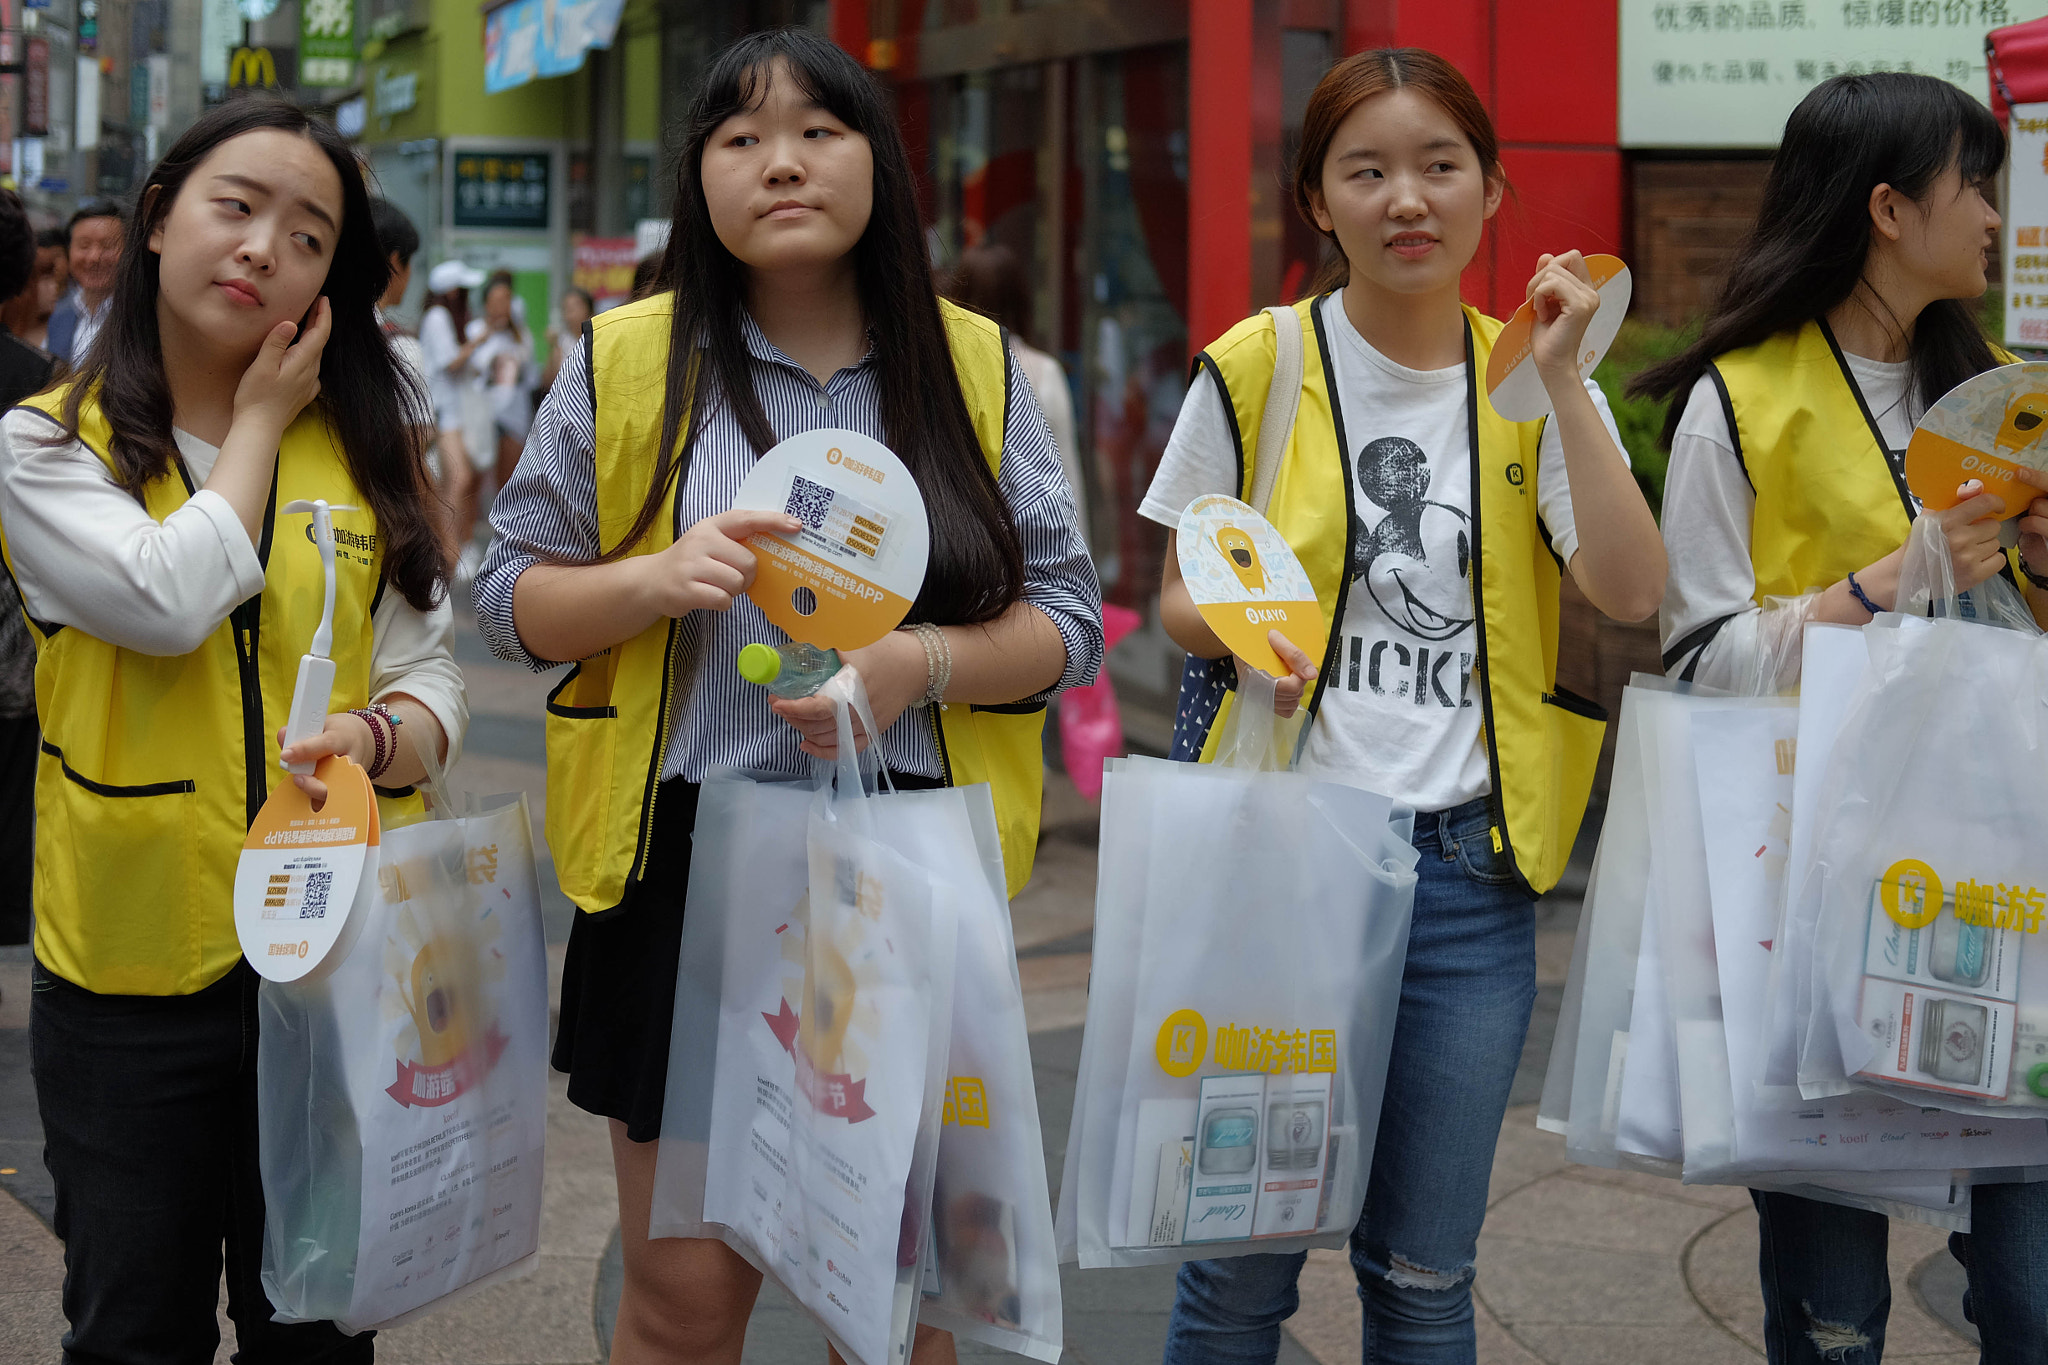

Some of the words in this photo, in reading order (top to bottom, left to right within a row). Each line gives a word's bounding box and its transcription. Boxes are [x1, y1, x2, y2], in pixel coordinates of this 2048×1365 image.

[842, 456, 885, 485] 咖游韩国
[1976, 461, 2015, 482] KAYO
[1257, 608, 1288, 622] KAYO
[1954, 877, 2048, 935] 咖游
[1214, 1022, 1337, 1075] 咖游韩国
